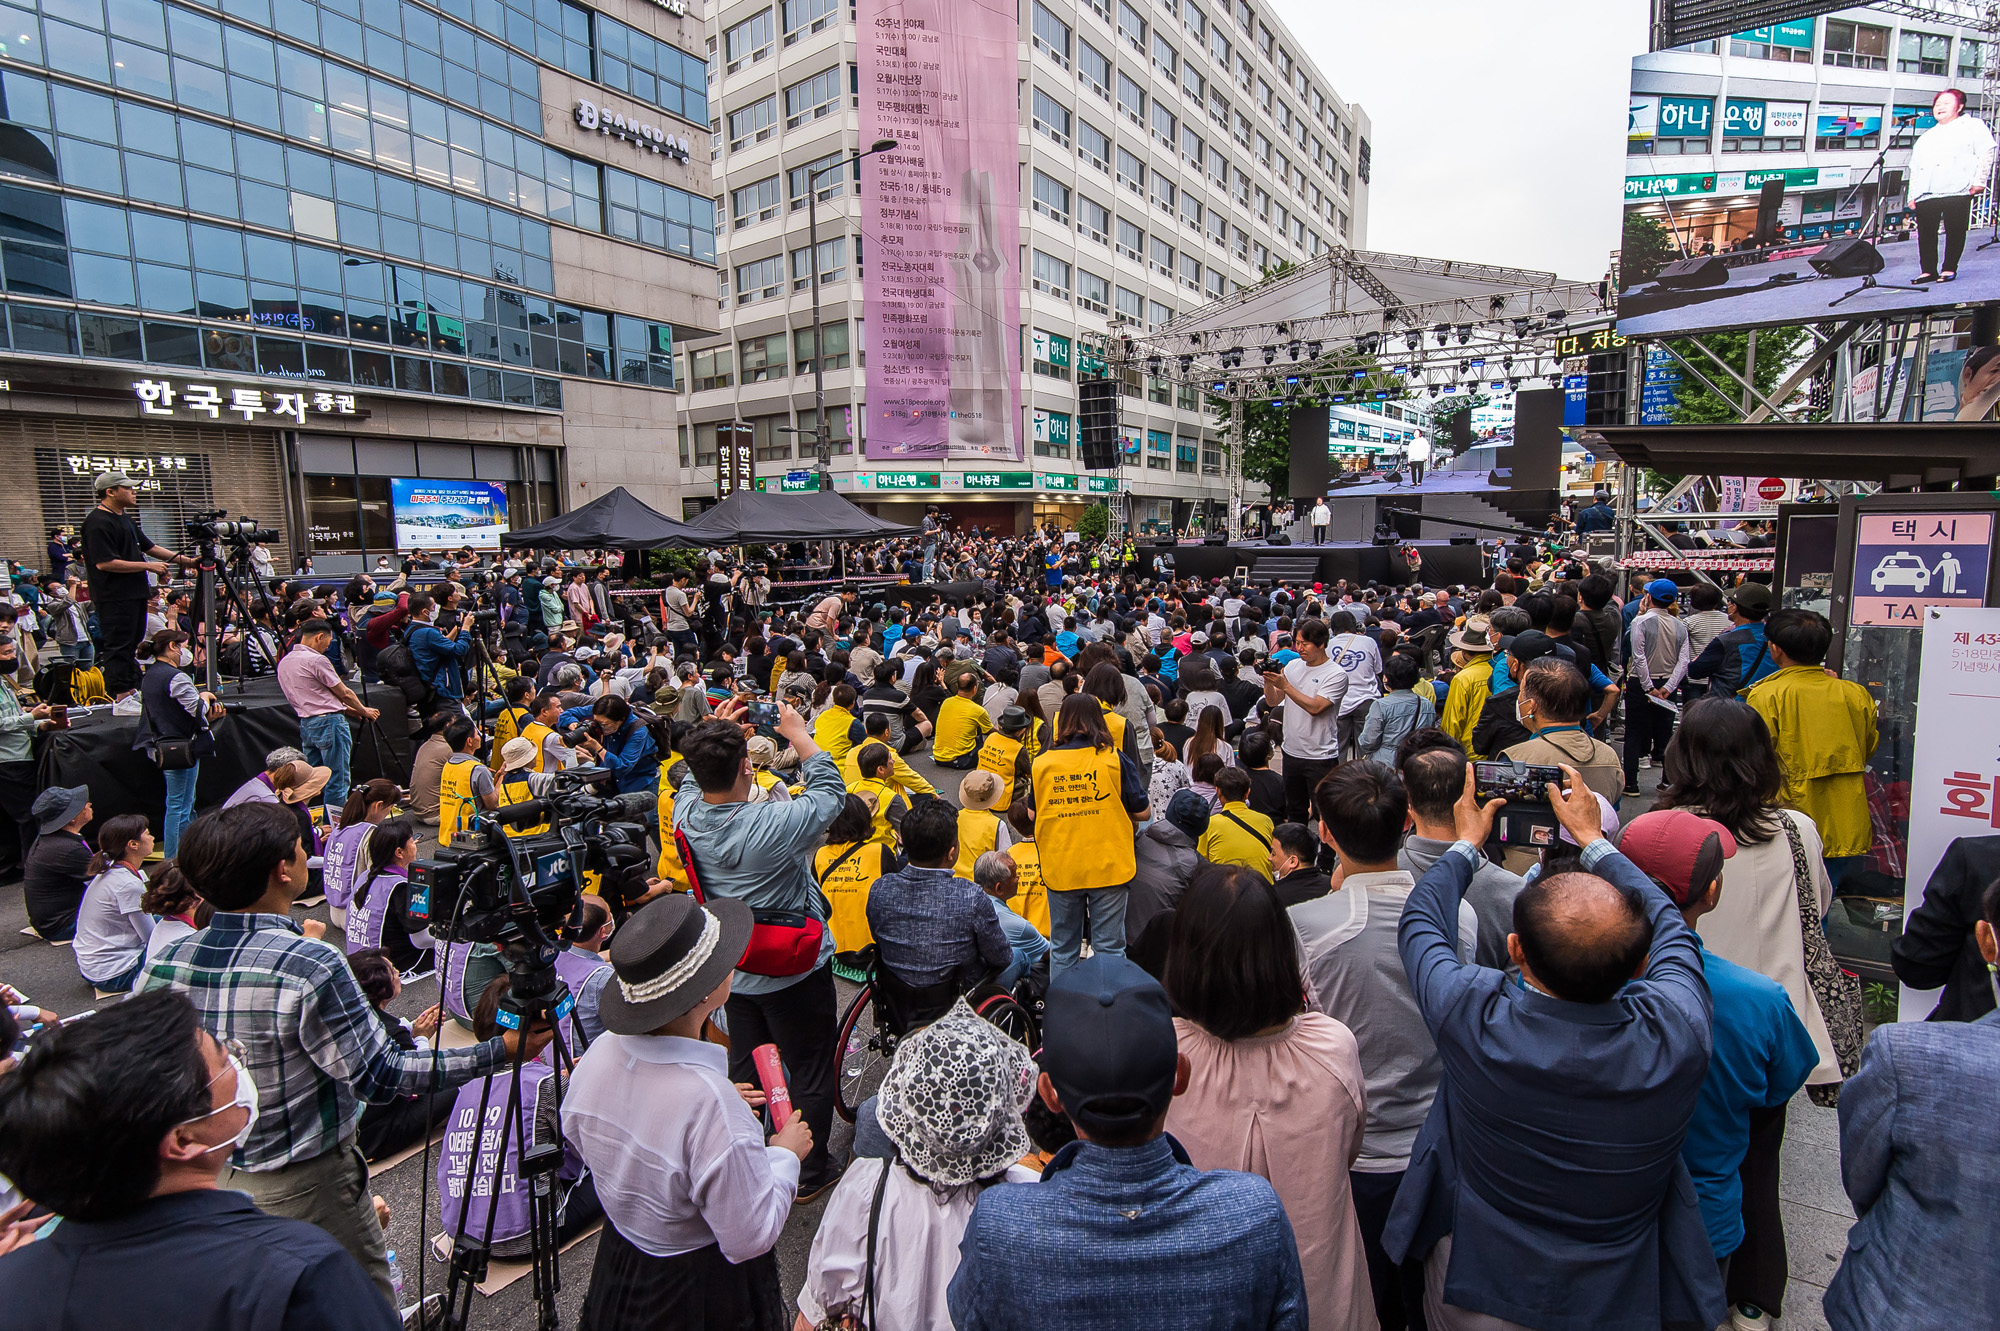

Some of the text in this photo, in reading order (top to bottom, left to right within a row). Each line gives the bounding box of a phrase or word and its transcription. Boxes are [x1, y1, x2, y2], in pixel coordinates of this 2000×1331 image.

[875, 19, 900, 29] 43주년
[876, 45, 907, 57] 국민대회
[876, 73, 922, 85] 오월시민난장
[877, 101, 929, 114] 민주평화대행진
[1662, 103, 1763, 131] 하나 은행
[601, 107, 689, 153] SANGDAN
[878, 128, 918, 140] 기념 토론회
[879, 154, 924, 167] 오월역사배움
[1625, 178, 1678, 195] 하나은행
[880, 208, 918, 220] 정부기념식
[881, 235, 904, 246] 추모제
[881, 261, 934, 272] 전국노동자대회
[881, 288, 934, 298] 전국대학생대회
[882, 313, 928, 324] 민족평화포럼
[882, 339, 920, 350] 오월여성제
[1051, 341, 1069, 363] 하나
[132, 379, 356, 424] 한국투자 증권
[884, 399, 945, 408] www.518people.org
[1051, 419, 1069, 441] 하나
[67, 455, 188, 476] 한국투자 증권
[720, 446, 731, 500] 한국투
[877, 474, 917, 487] 하나은행
[966, 474, 1000, 487] 하나증권
[1045, 475, 1065, 488] 하나은행
[1891, 519, 1957, 541] 택시
[1953, 632, 1970, 645] 제
[1053, 770, 1111, 801] 민주, 평화 길
[1068, 783, 1087, 792] 안전의
[1048, 797, 1065, 805] 우리가
[1067, 796, 1079, 804] 함께
